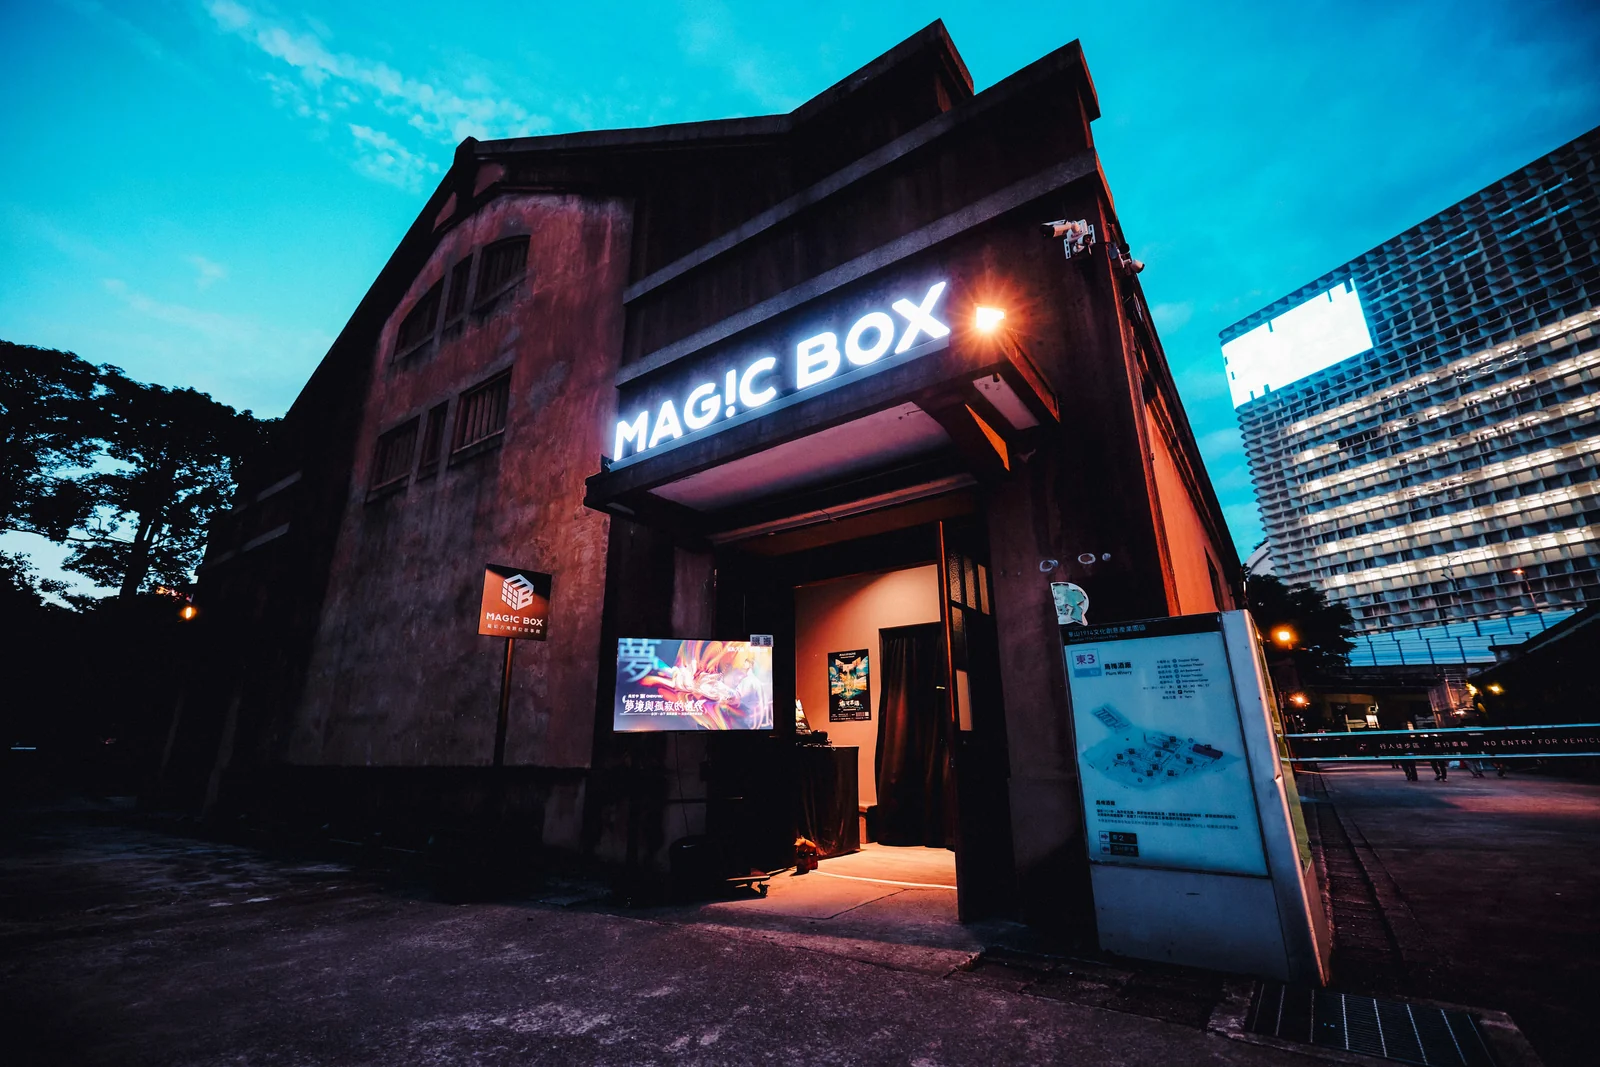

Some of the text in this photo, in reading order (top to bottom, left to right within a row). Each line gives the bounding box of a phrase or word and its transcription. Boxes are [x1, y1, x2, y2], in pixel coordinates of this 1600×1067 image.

[797, 281, 950, 389] BOX
[523, 617, 543, 626] BOX
[1076, 654, 1095, 665] 東3
